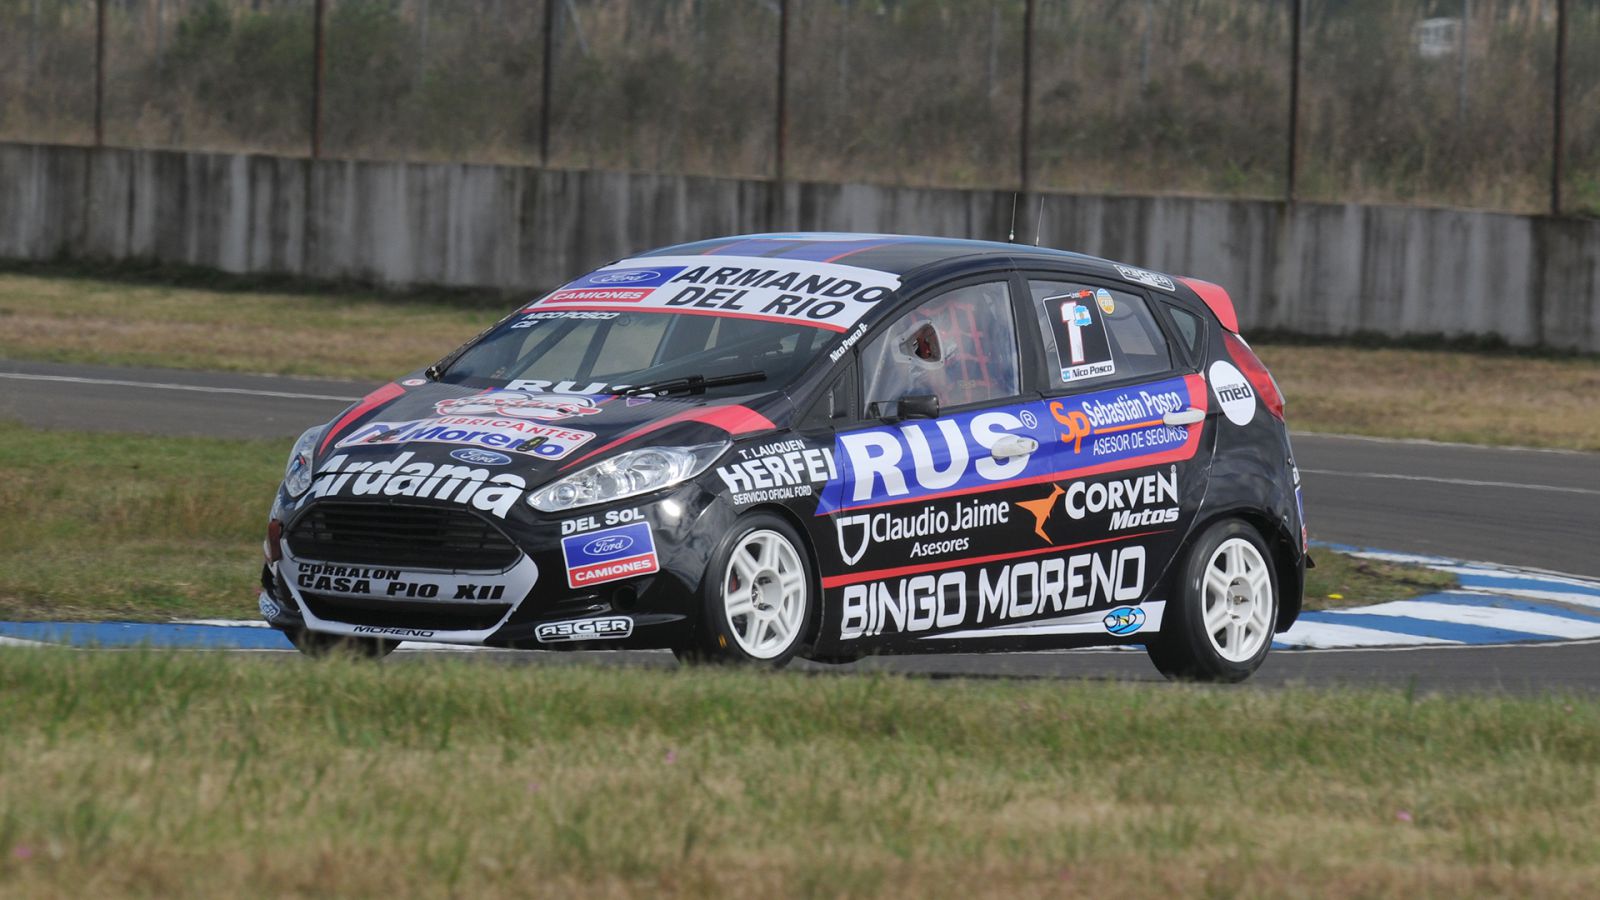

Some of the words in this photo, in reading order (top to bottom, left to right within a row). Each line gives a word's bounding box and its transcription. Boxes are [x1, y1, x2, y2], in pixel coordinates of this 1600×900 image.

[552, 291, 644, 301] CAMIONES
[672, 266, 893, 303] ARMANDO
[560, 312, 620, 320] POSCO
[664, 286, 749, 311] DEL
[760, 294, 846, 320] RIO
[1060, 301, 1085, 365] 1
[1072, 367, 1089, 378] Nico
[1090, 364, 1113, 375] Posco
[1218, 382, 1252, 403] med
[1050, 401, 1091, 454] Sp
[1082, 394, 1145, 428] Sebastián
[1139, 390, 1182, 417] Posco
[738, 449, 752, 460] T.
[752, 439, 806, 458] LAUQUEN
[1093, 433, 1129, 456] ASESOR
[1131, 431, 1144, 450] DE
[1145, 426, 1188, 447] SEGUROS
[716, 447, 838, 494] HERFEI
[840, 412, 1031, 502] RUS
[294, 451, 526, 519] Ardama
[733, 489, 768, 505] SERVICIO
[769, 486, 795, 501] OFICIAL
[794, 485, 812, 498] FORD
[1065, 470, 1178, 520] CORVEN
[561, 516, 601, 535] DEL
[605, 507, 645, 526] SOL
[871, 506, 949, 543] Claudio
[951, 499, 1010, 531] Jaime
[1108, 507, 1180, 531] Motos
[910, 537, 970, 559] Asesores
[298, 562, 402, 581] CORRALON
[575, 559, 652, 581] CAMIONES
[297, 574, 371, 594] CASA
[386, 582, 440, 599] PIO
[452, 583, 507, 601] XII
[839, 571, 966, 640] BINGO
[976, 545, 1146, 623] MORENO
[353, 624, 435, 638] MORENO
